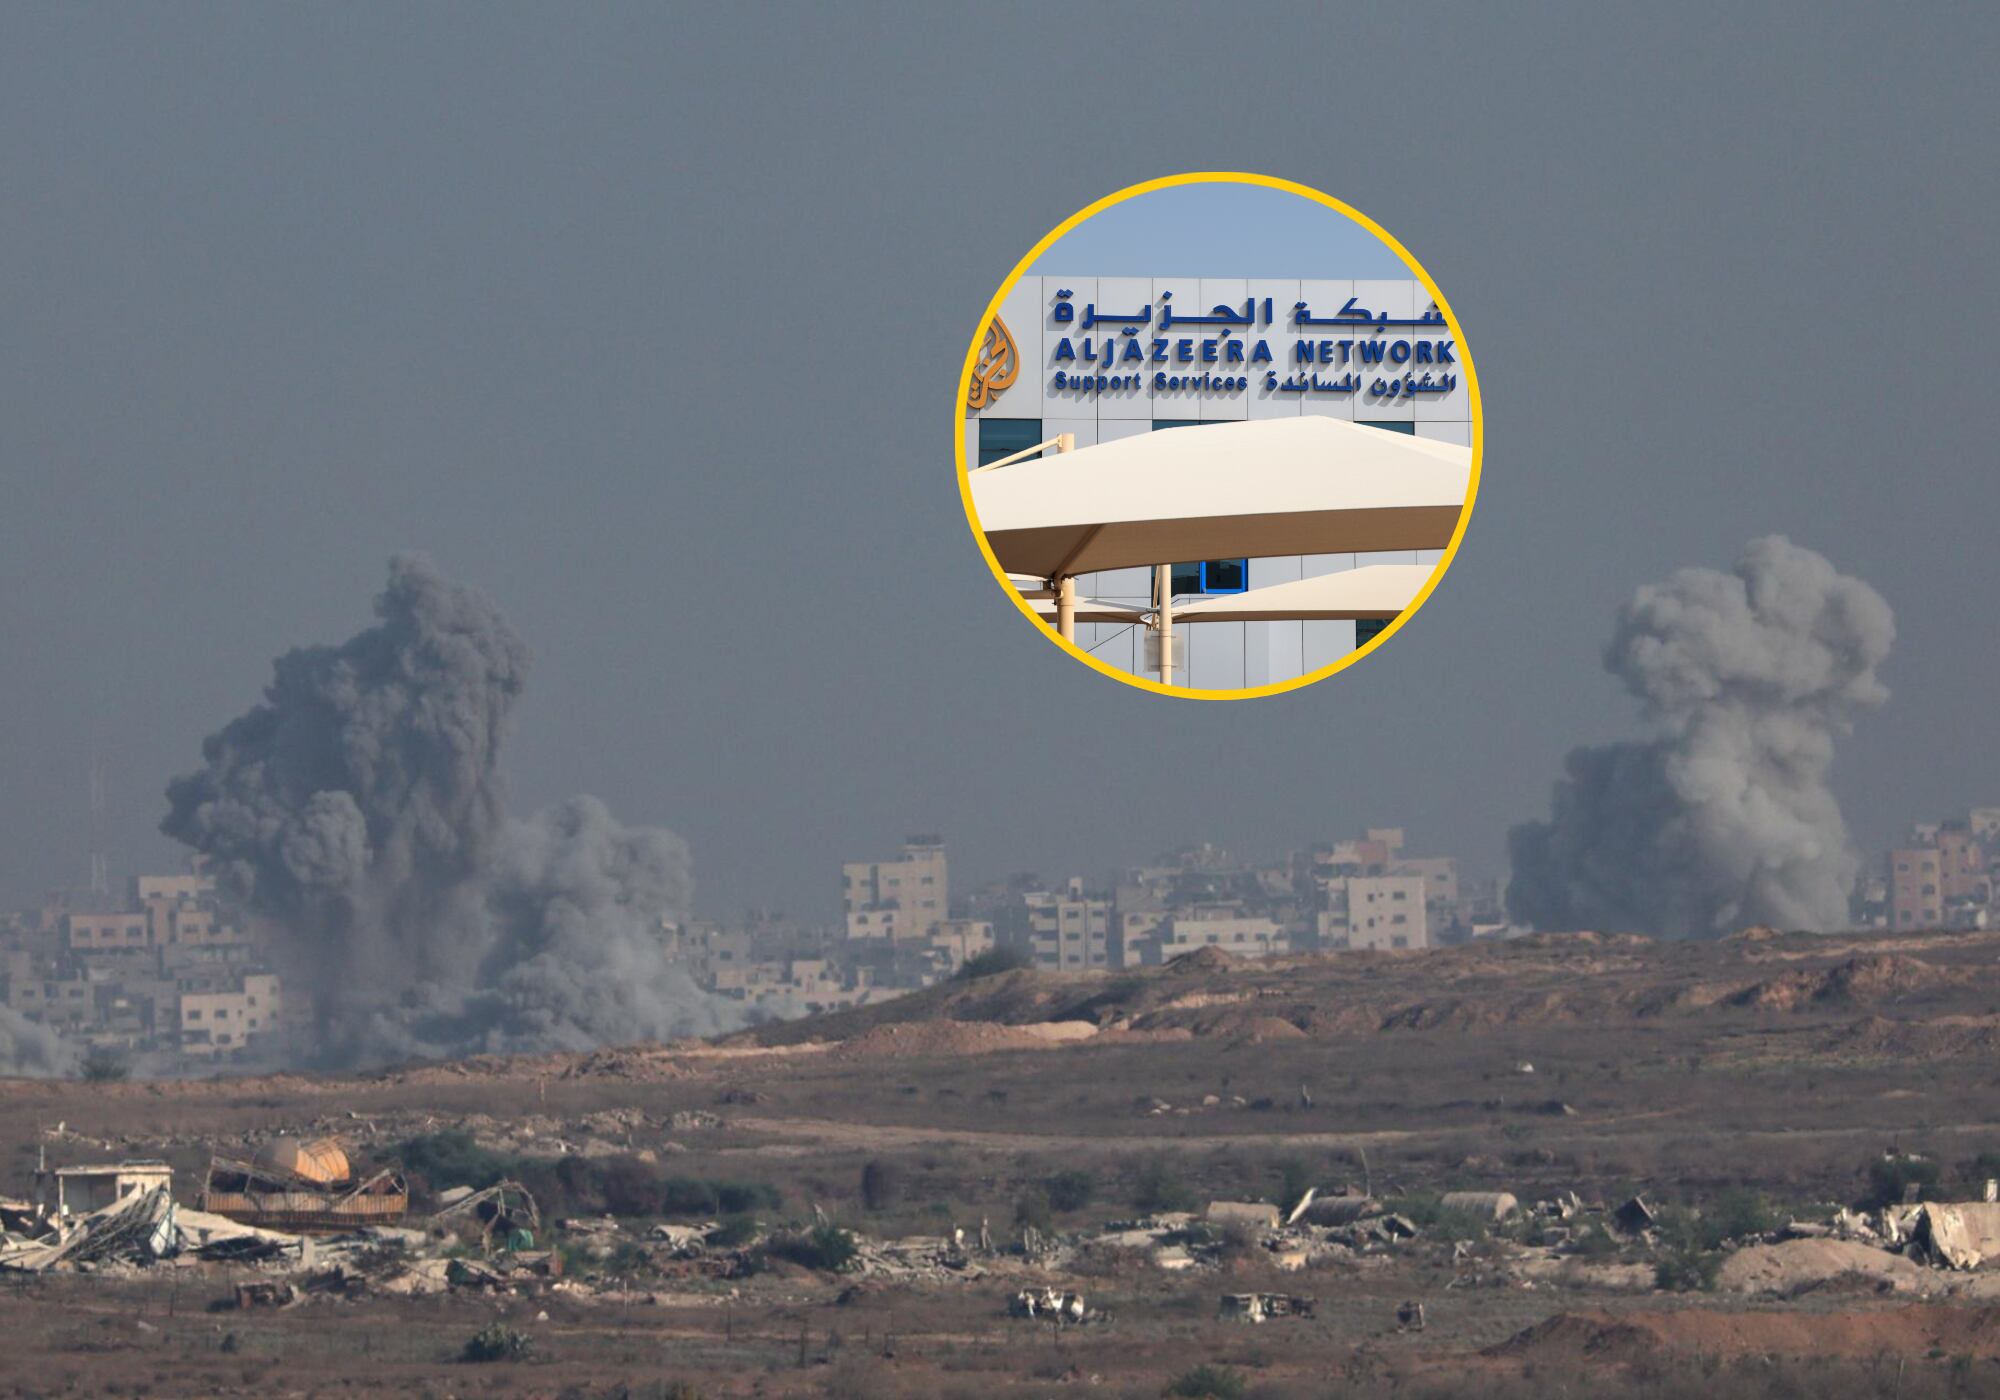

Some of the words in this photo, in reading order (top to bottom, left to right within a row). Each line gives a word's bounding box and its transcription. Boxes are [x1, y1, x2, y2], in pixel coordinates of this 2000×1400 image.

[1055, 289, 1273, 337] الجزيرة
[1055, 337, 1273, 368] ALJAZEERA
[1296, 339, 1456, 363] NETWORK
[1055, 370, 1141, 394] Support
[1154, 371, 1248, 389] Services
[1371, 371, 1457, 398] الشؤون
